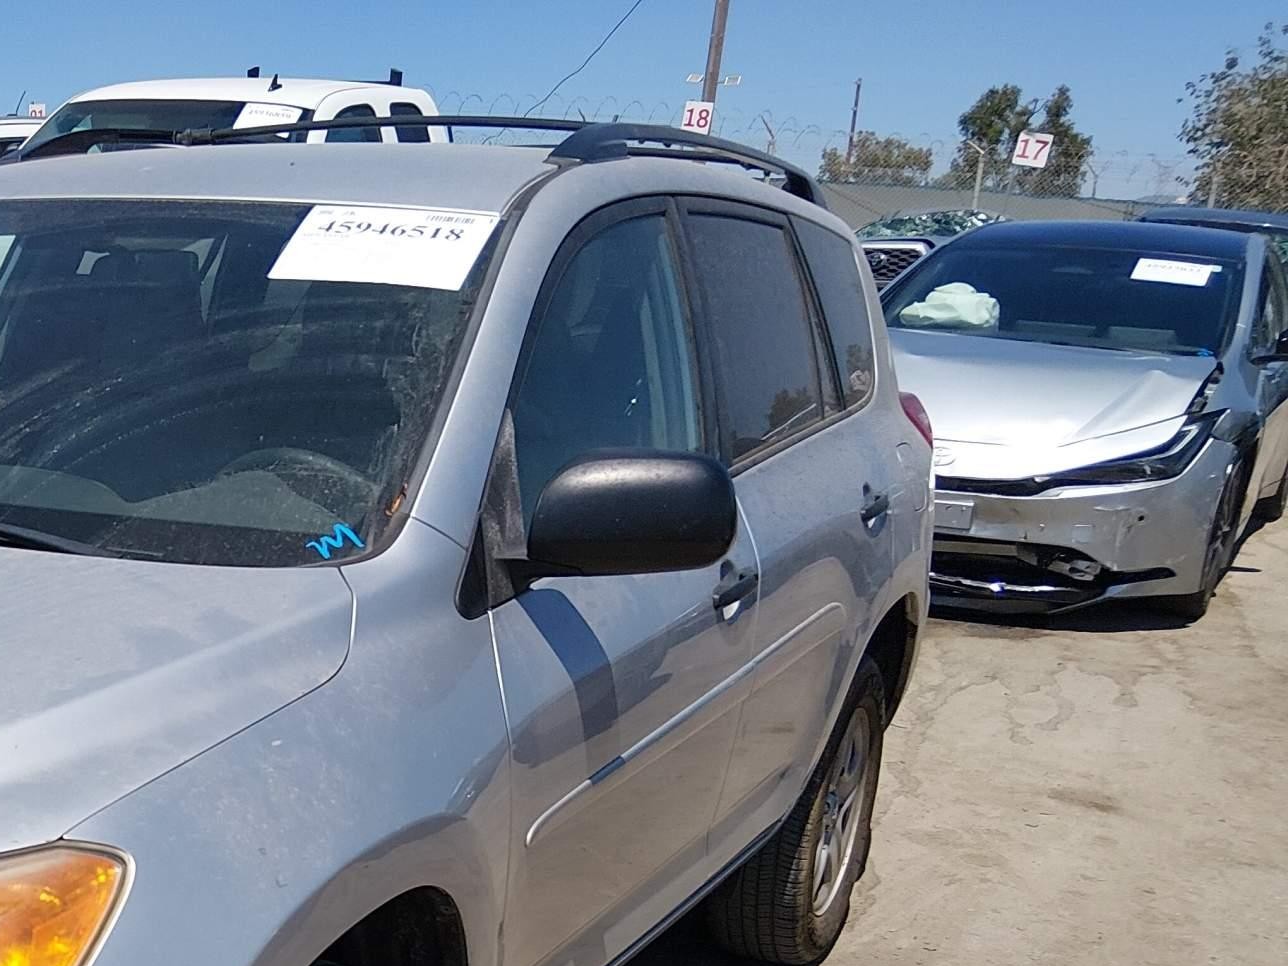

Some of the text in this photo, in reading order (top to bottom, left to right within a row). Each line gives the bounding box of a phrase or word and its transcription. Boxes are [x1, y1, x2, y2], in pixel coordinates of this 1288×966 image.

[684, 108, 710, 128] 18
[1016, 138, 1050, 161] 17
[317, 219, 465, 242] 45946518
